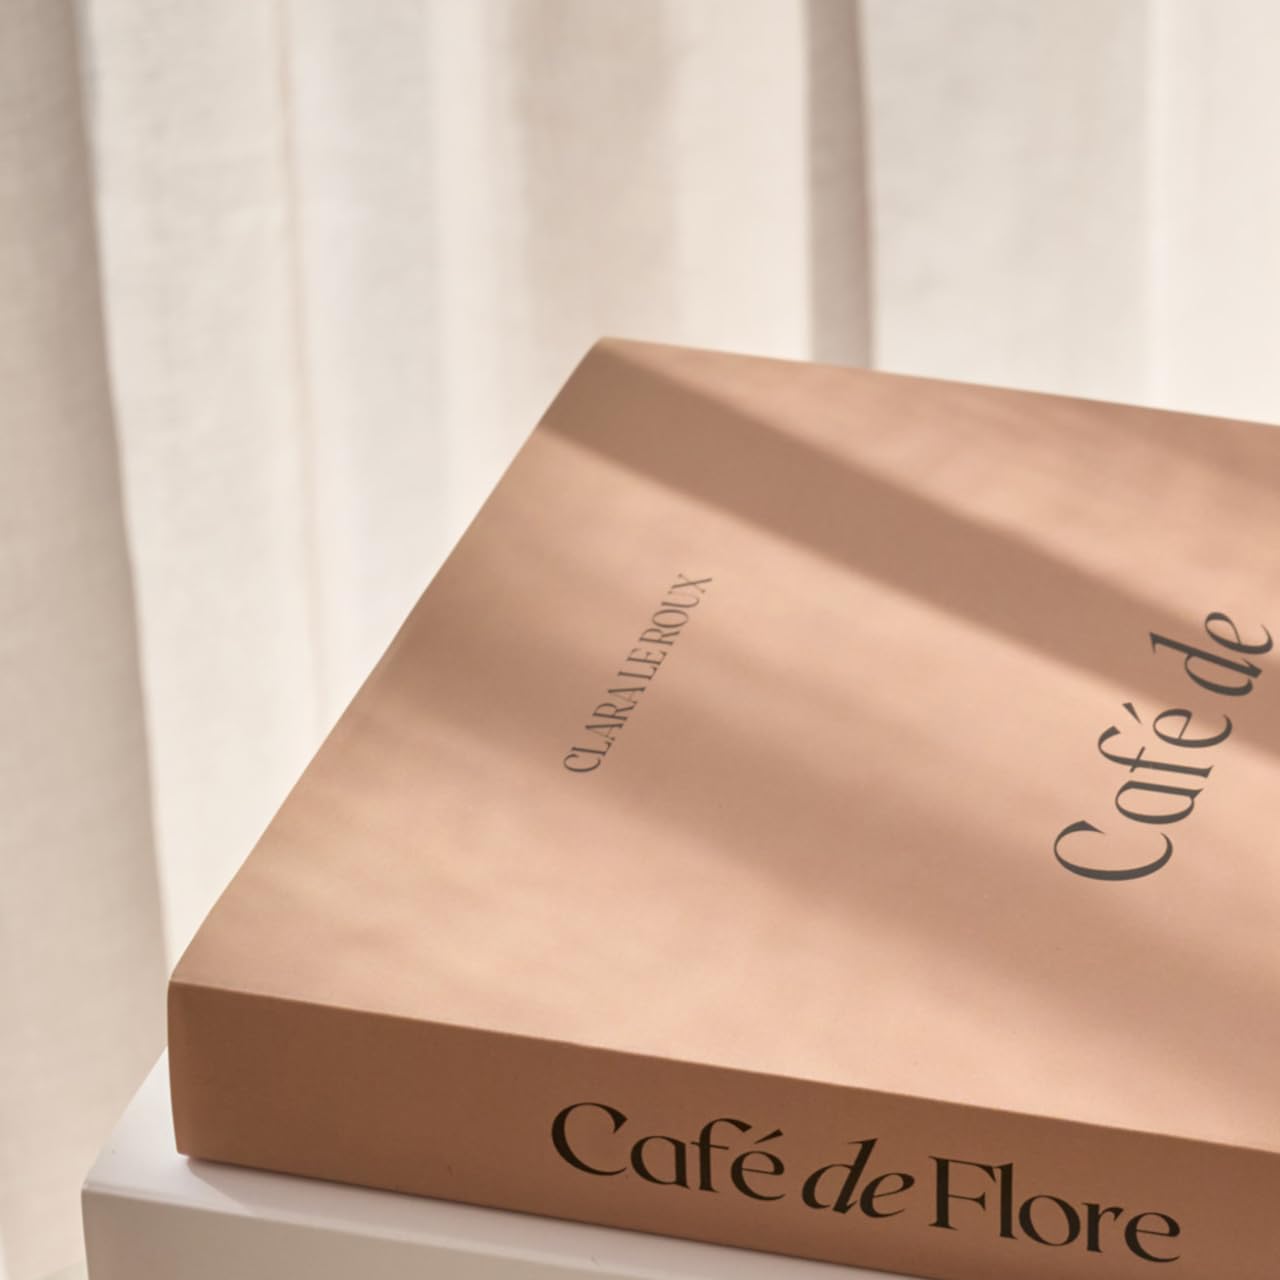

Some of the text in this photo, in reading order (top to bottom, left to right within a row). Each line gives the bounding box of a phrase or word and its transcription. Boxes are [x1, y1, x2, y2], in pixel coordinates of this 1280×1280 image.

[1054, 612, 1274, 881] Café de
[551, 1102, 1181, 1263] Café de Flore
